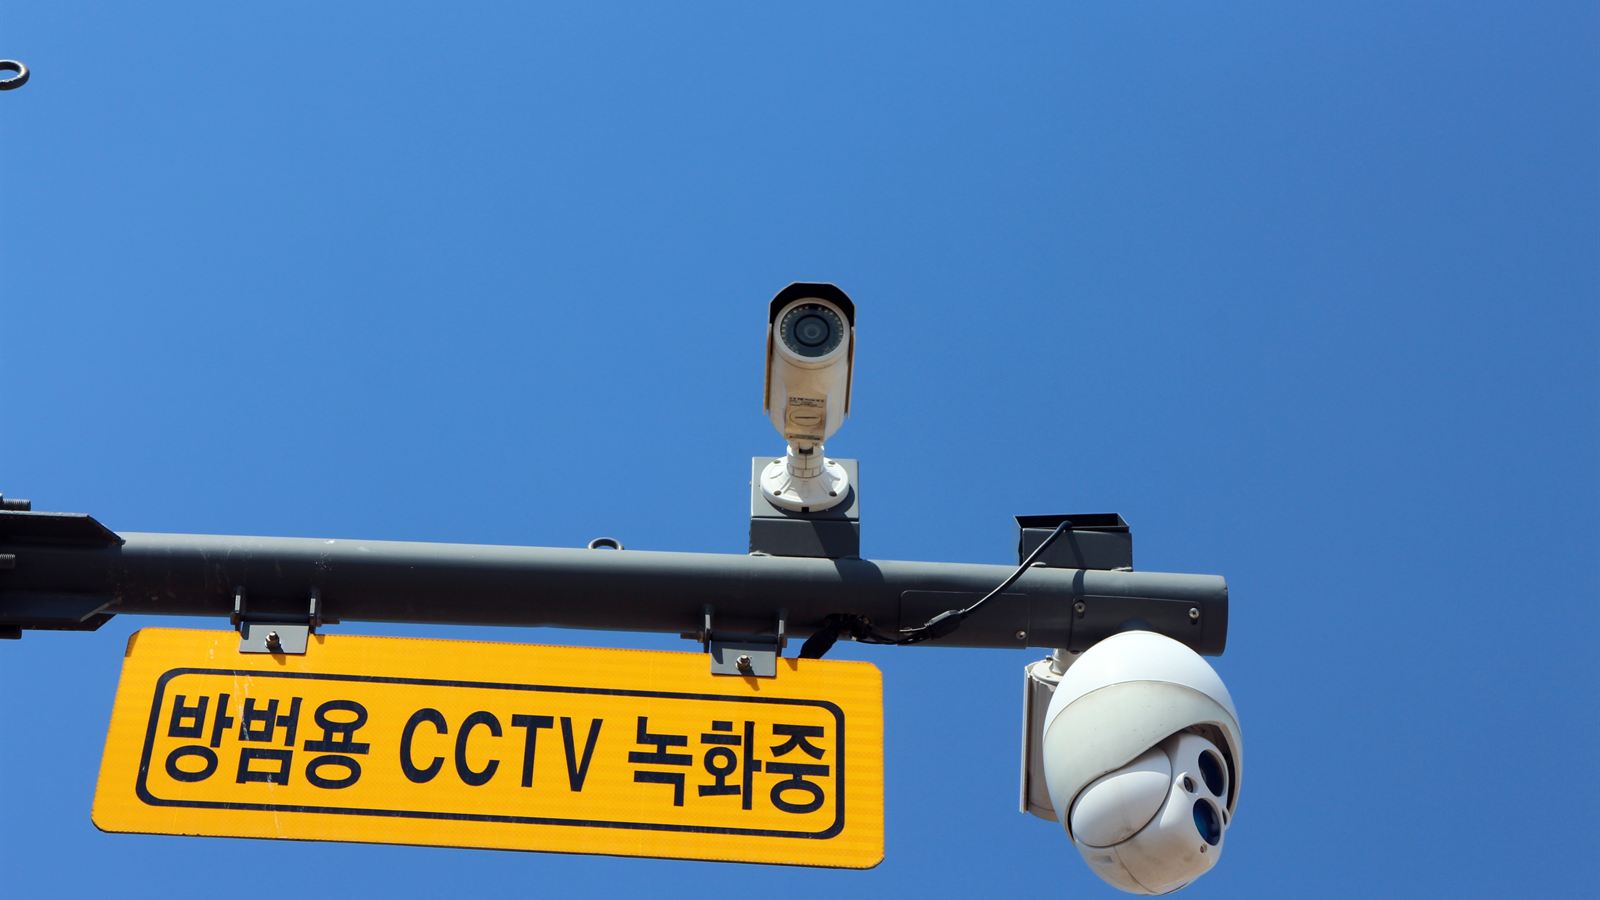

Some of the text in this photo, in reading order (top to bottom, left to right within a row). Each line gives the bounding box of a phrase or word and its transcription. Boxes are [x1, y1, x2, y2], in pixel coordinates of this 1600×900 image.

[166, 694, 829, 813] 방범용 CCTV 녹화중
